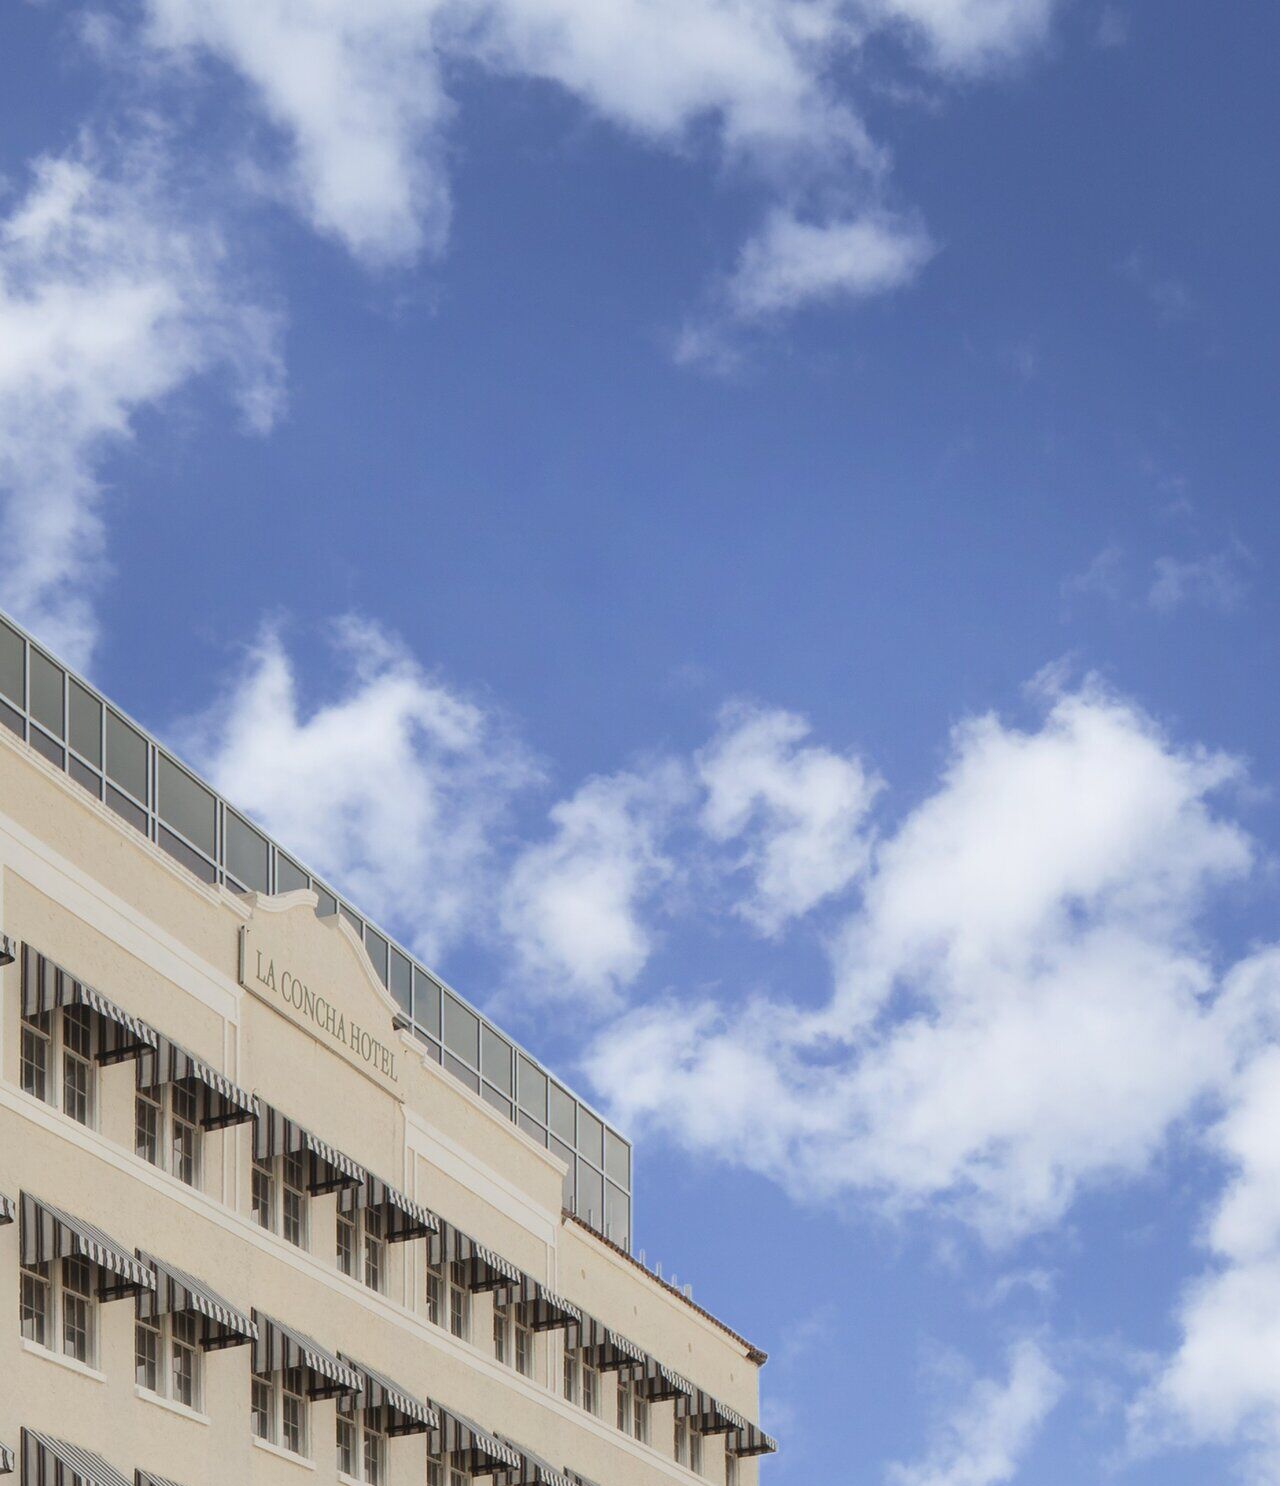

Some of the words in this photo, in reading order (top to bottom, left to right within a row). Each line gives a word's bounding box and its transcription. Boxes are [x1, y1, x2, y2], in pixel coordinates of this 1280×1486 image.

[256, 950, 277, 992] LA
[281, 971, 347, 1044] CONCHA
[350, 1021, 398, 1082] HOTEL
